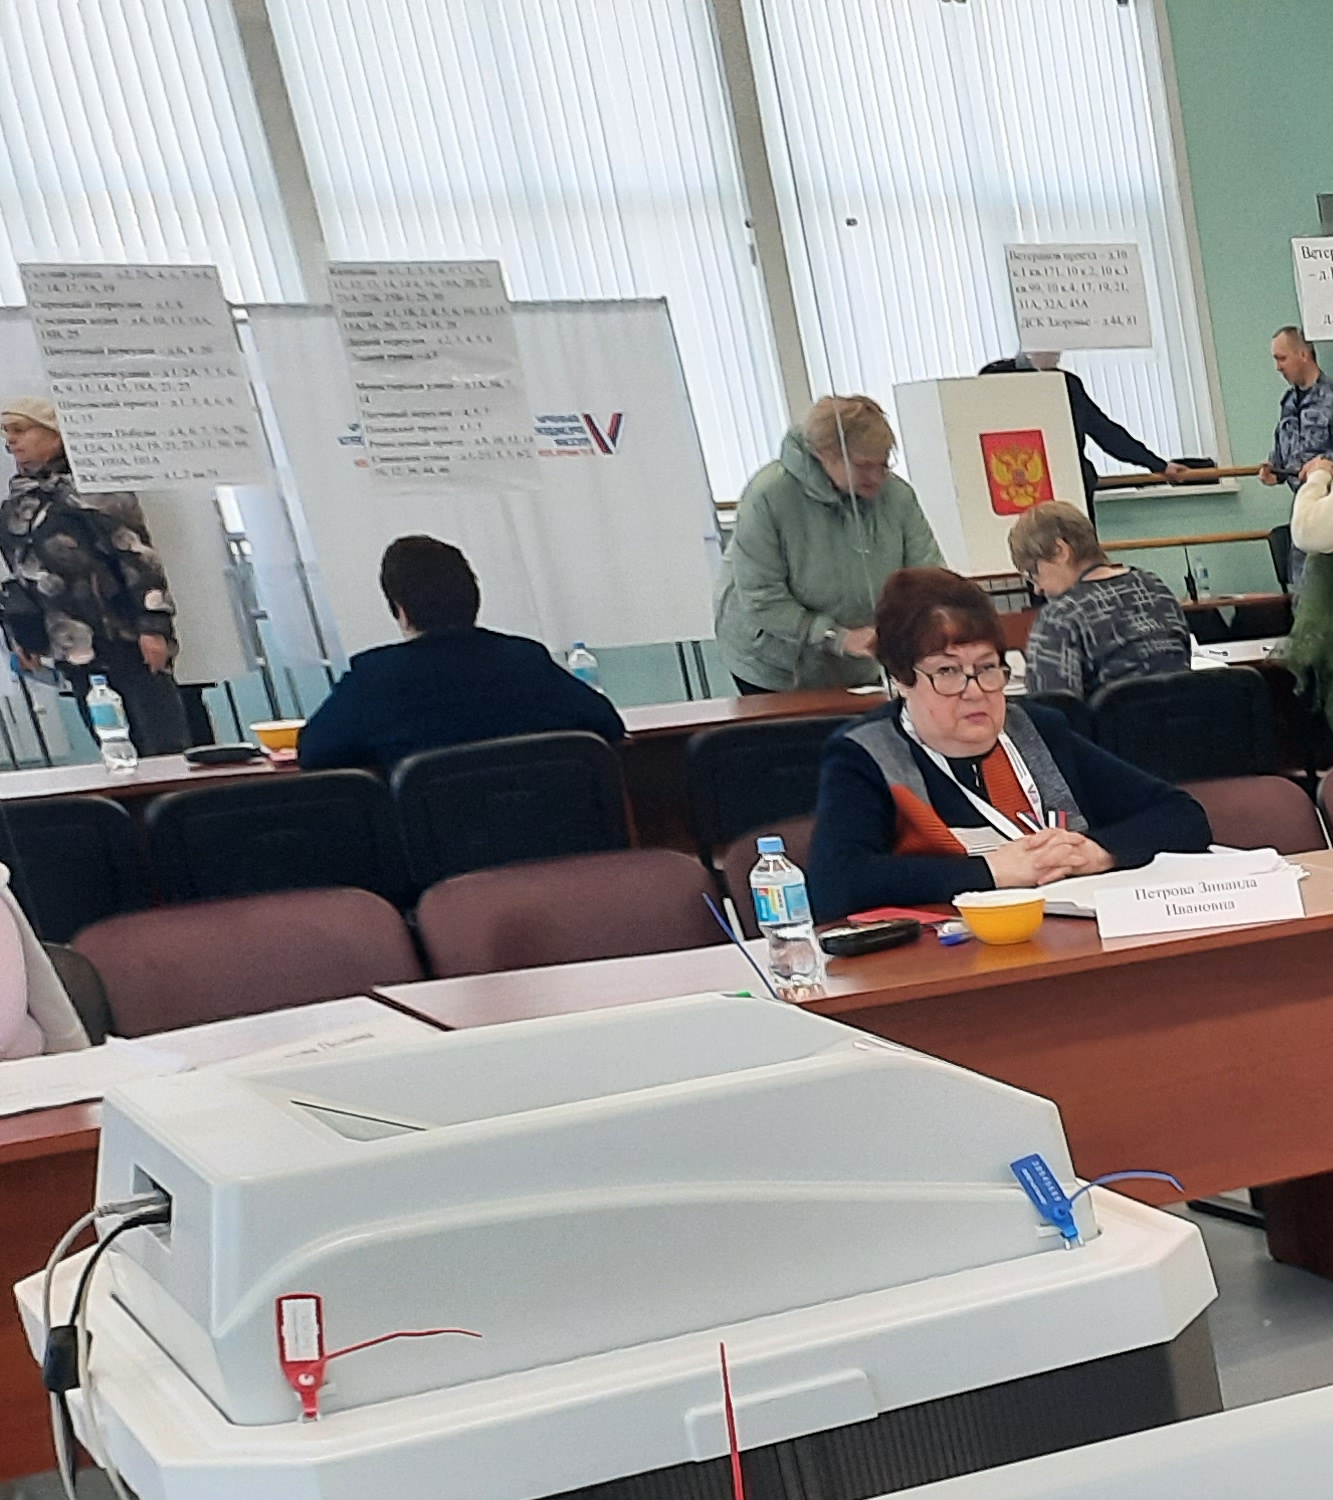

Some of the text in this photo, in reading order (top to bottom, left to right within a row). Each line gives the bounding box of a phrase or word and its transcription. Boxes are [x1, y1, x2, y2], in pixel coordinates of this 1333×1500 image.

[1009, 251, 1061, 263] Ветеранов
[1134, 878, 1258, 902] Петрова Зинаида
[1165, 899, 1236, 917] Ивановна
